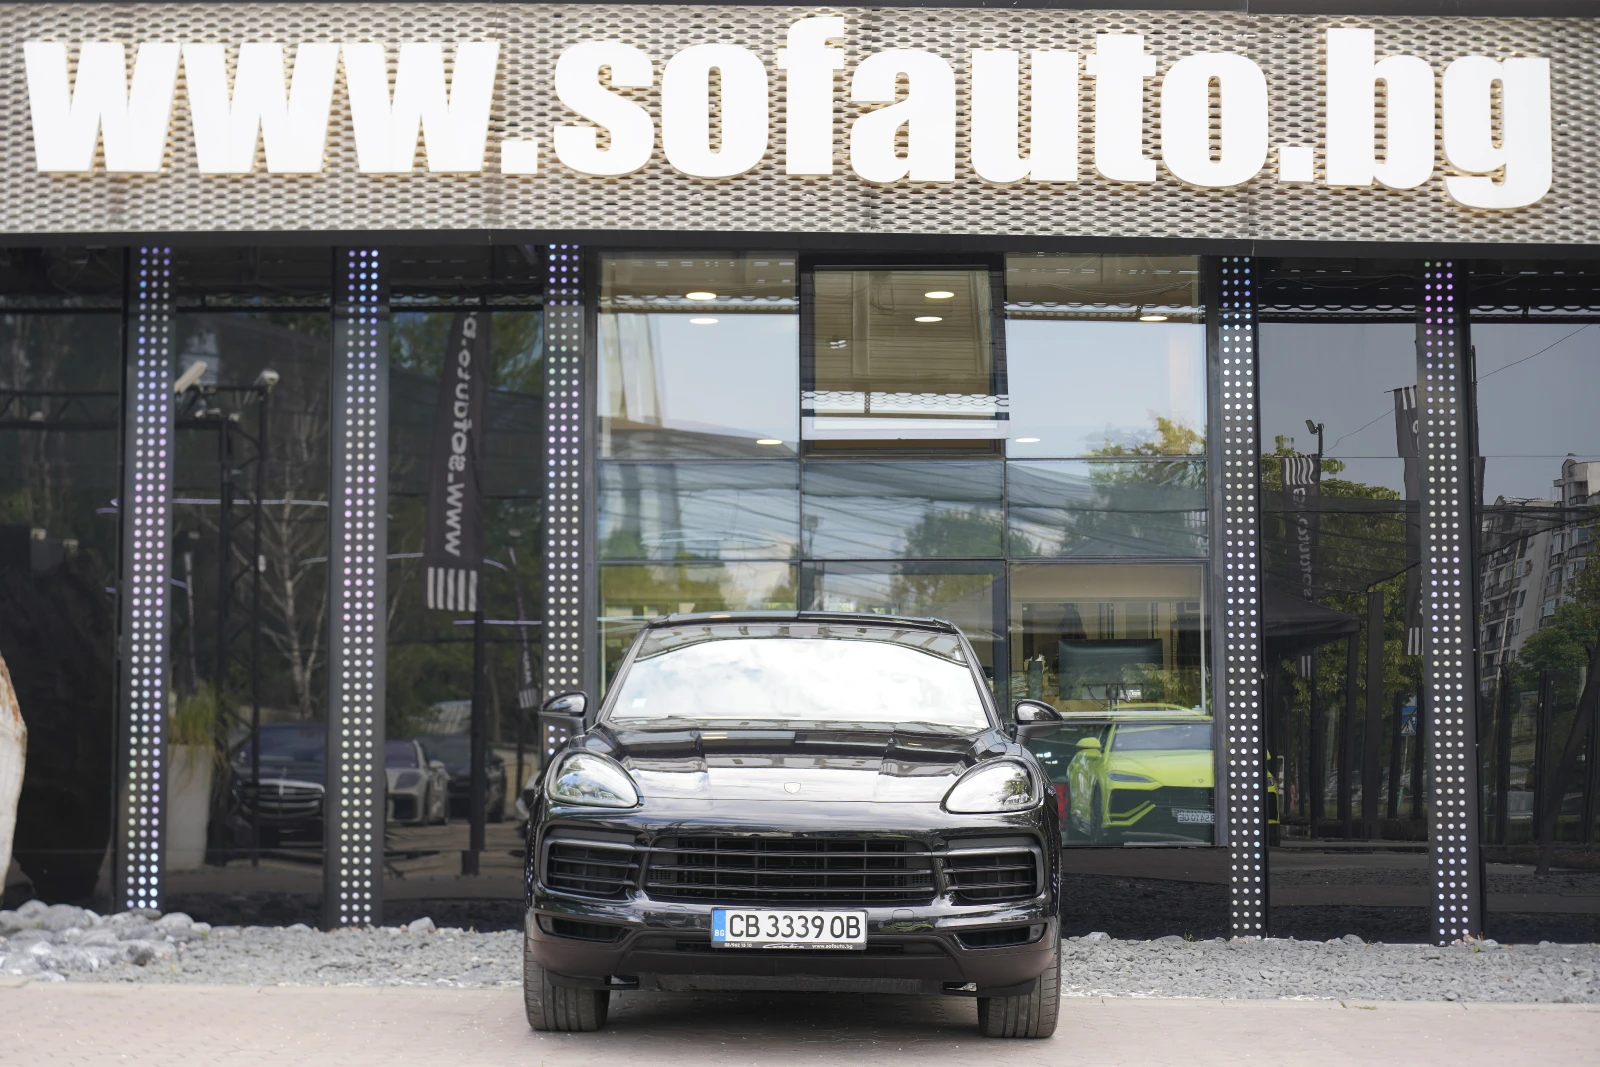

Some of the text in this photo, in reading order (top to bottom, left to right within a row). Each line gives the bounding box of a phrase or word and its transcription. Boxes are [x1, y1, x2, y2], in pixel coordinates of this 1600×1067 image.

[23, 16, 1552, 209] www.sofauto.bg
[714, 929, 725, 937] BG
[729, 914, 861, 939] CB 3339 OB
